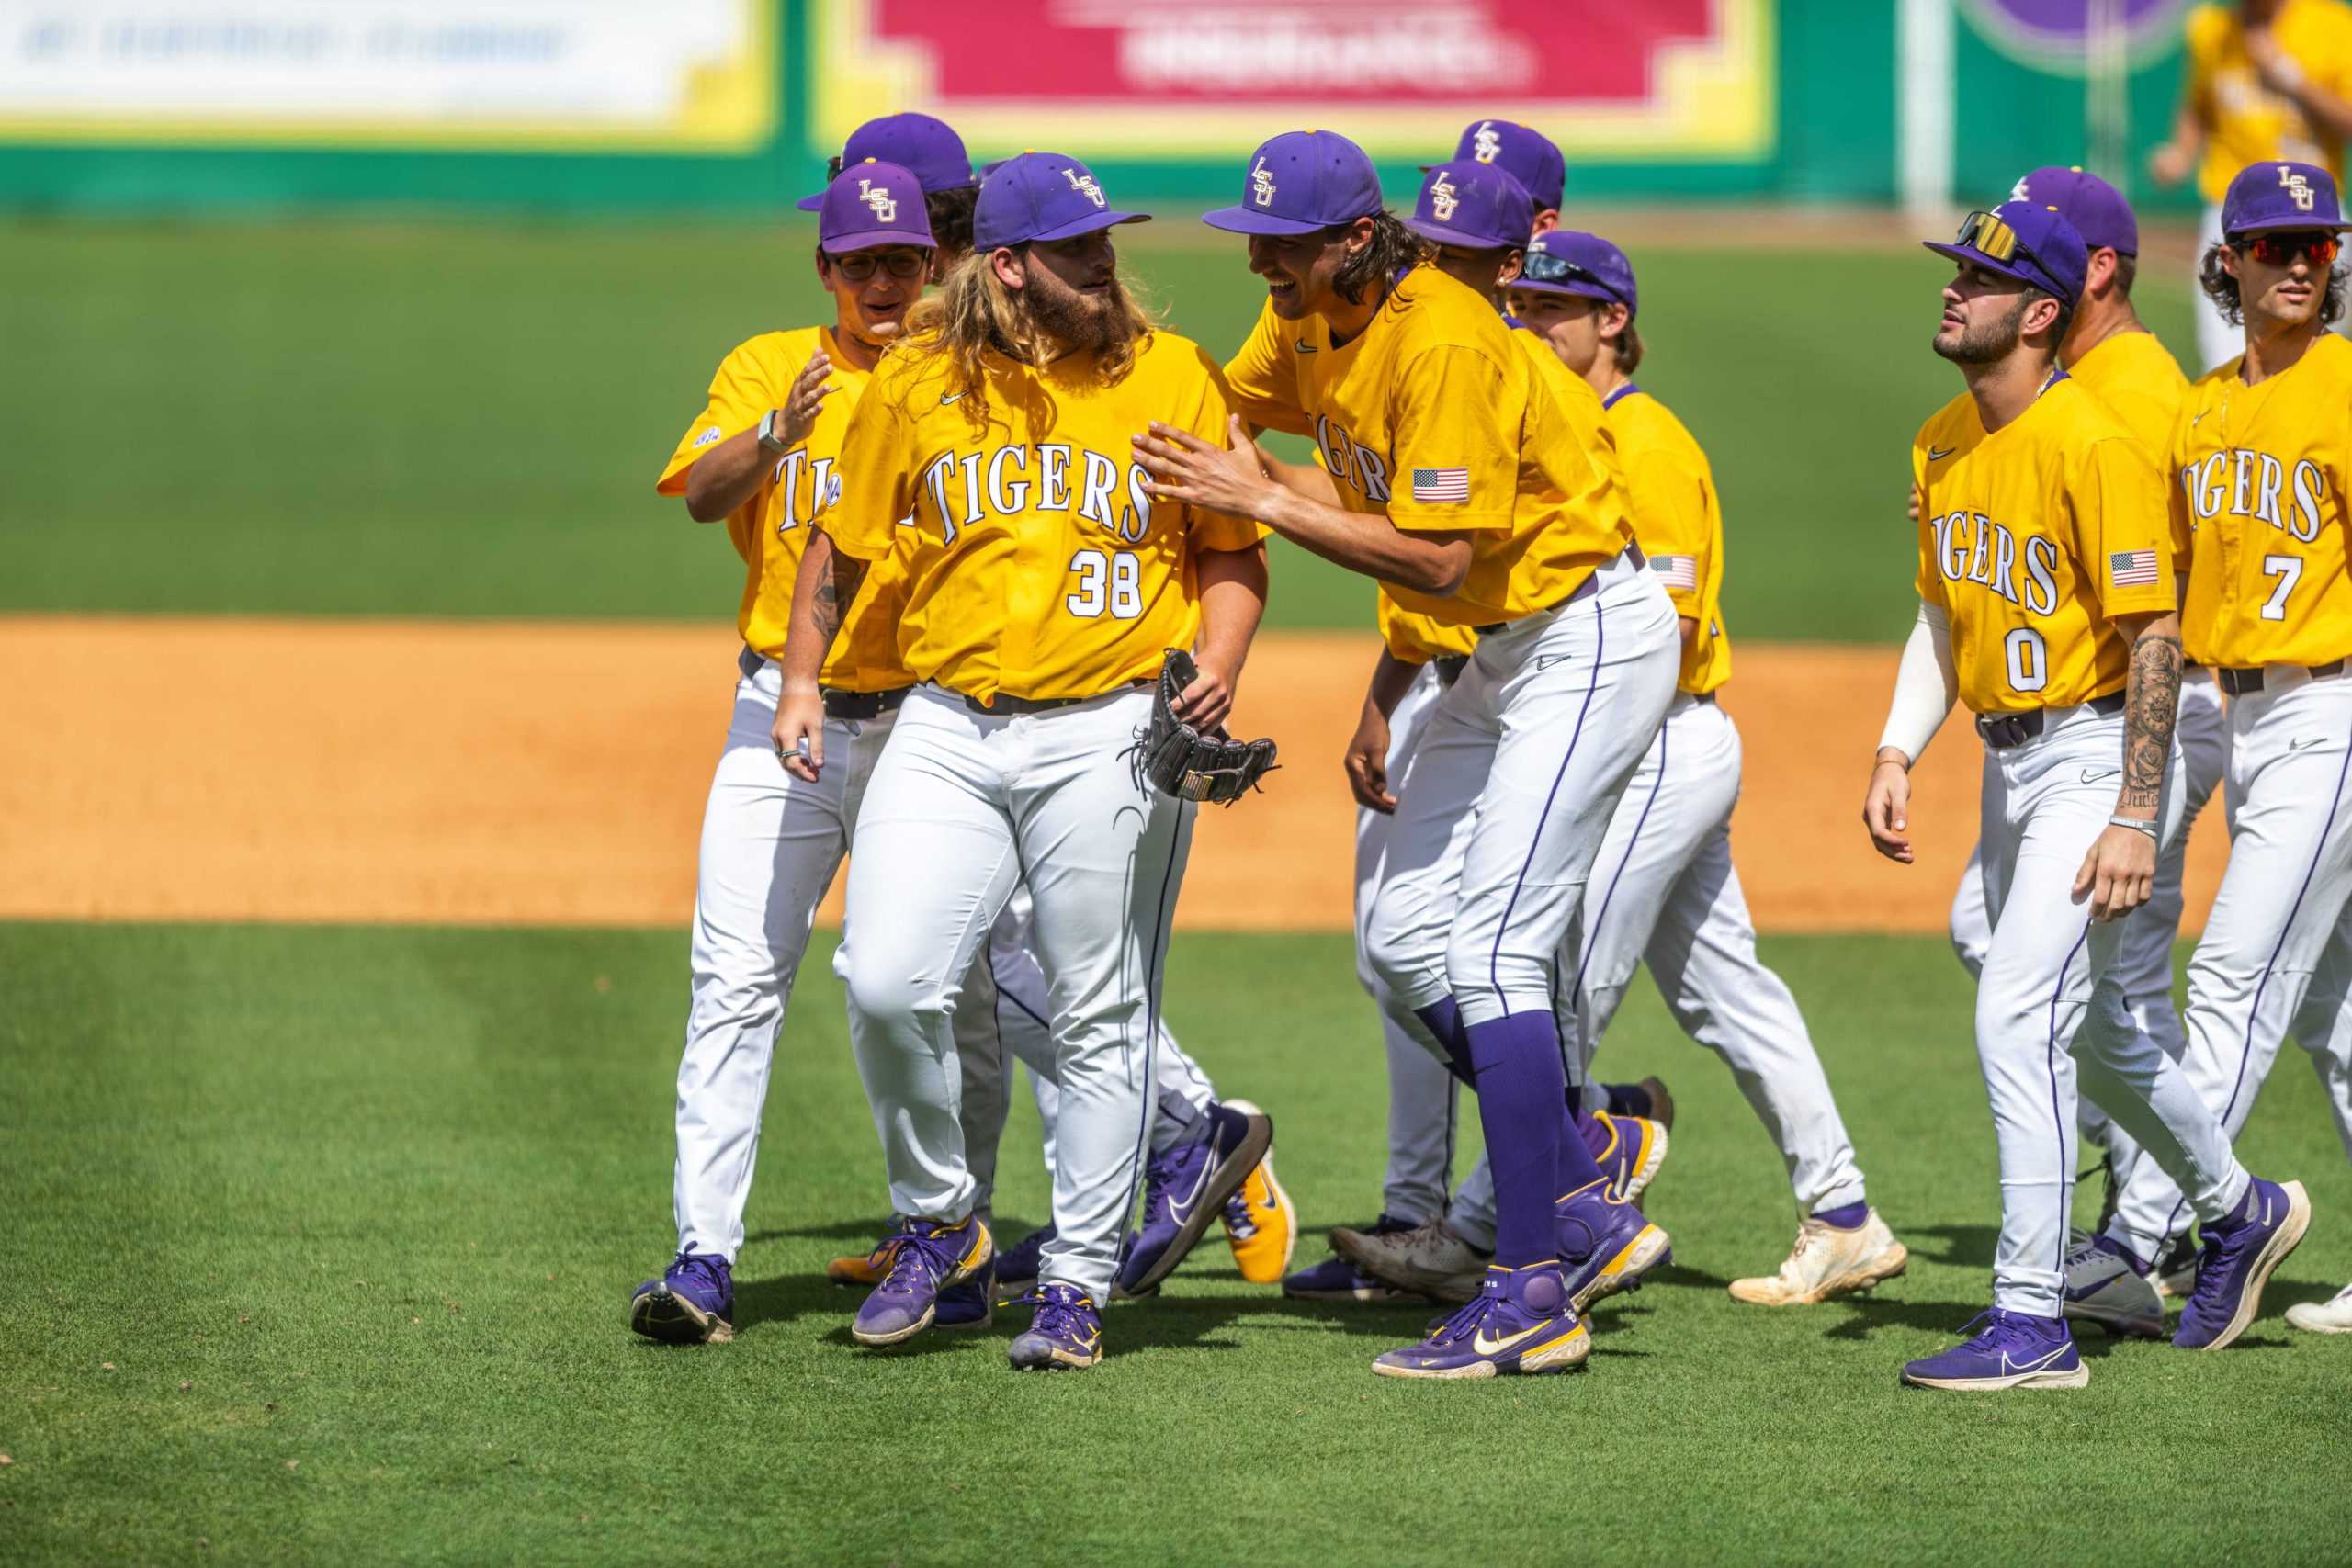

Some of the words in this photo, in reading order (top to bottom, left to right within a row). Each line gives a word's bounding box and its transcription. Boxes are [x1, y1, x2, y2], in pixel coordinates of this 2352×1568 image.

[859, 179, 897, 222] LSU
[1061, 168, 1105, 208] LSU
[1251, 156, 1276, 208] LSU
[1430, 171, 1459, 221] LSU
[2278, 165, 2314, 210] LSU
[924, 444, 1158, 545] TIGERS
[1066, 549, 1144, 619] 38
[1931, 511, 2059, 617] IGERS
[2260, 554, 2304, 621] 7
[2005, 626, 2048, 693] 0
